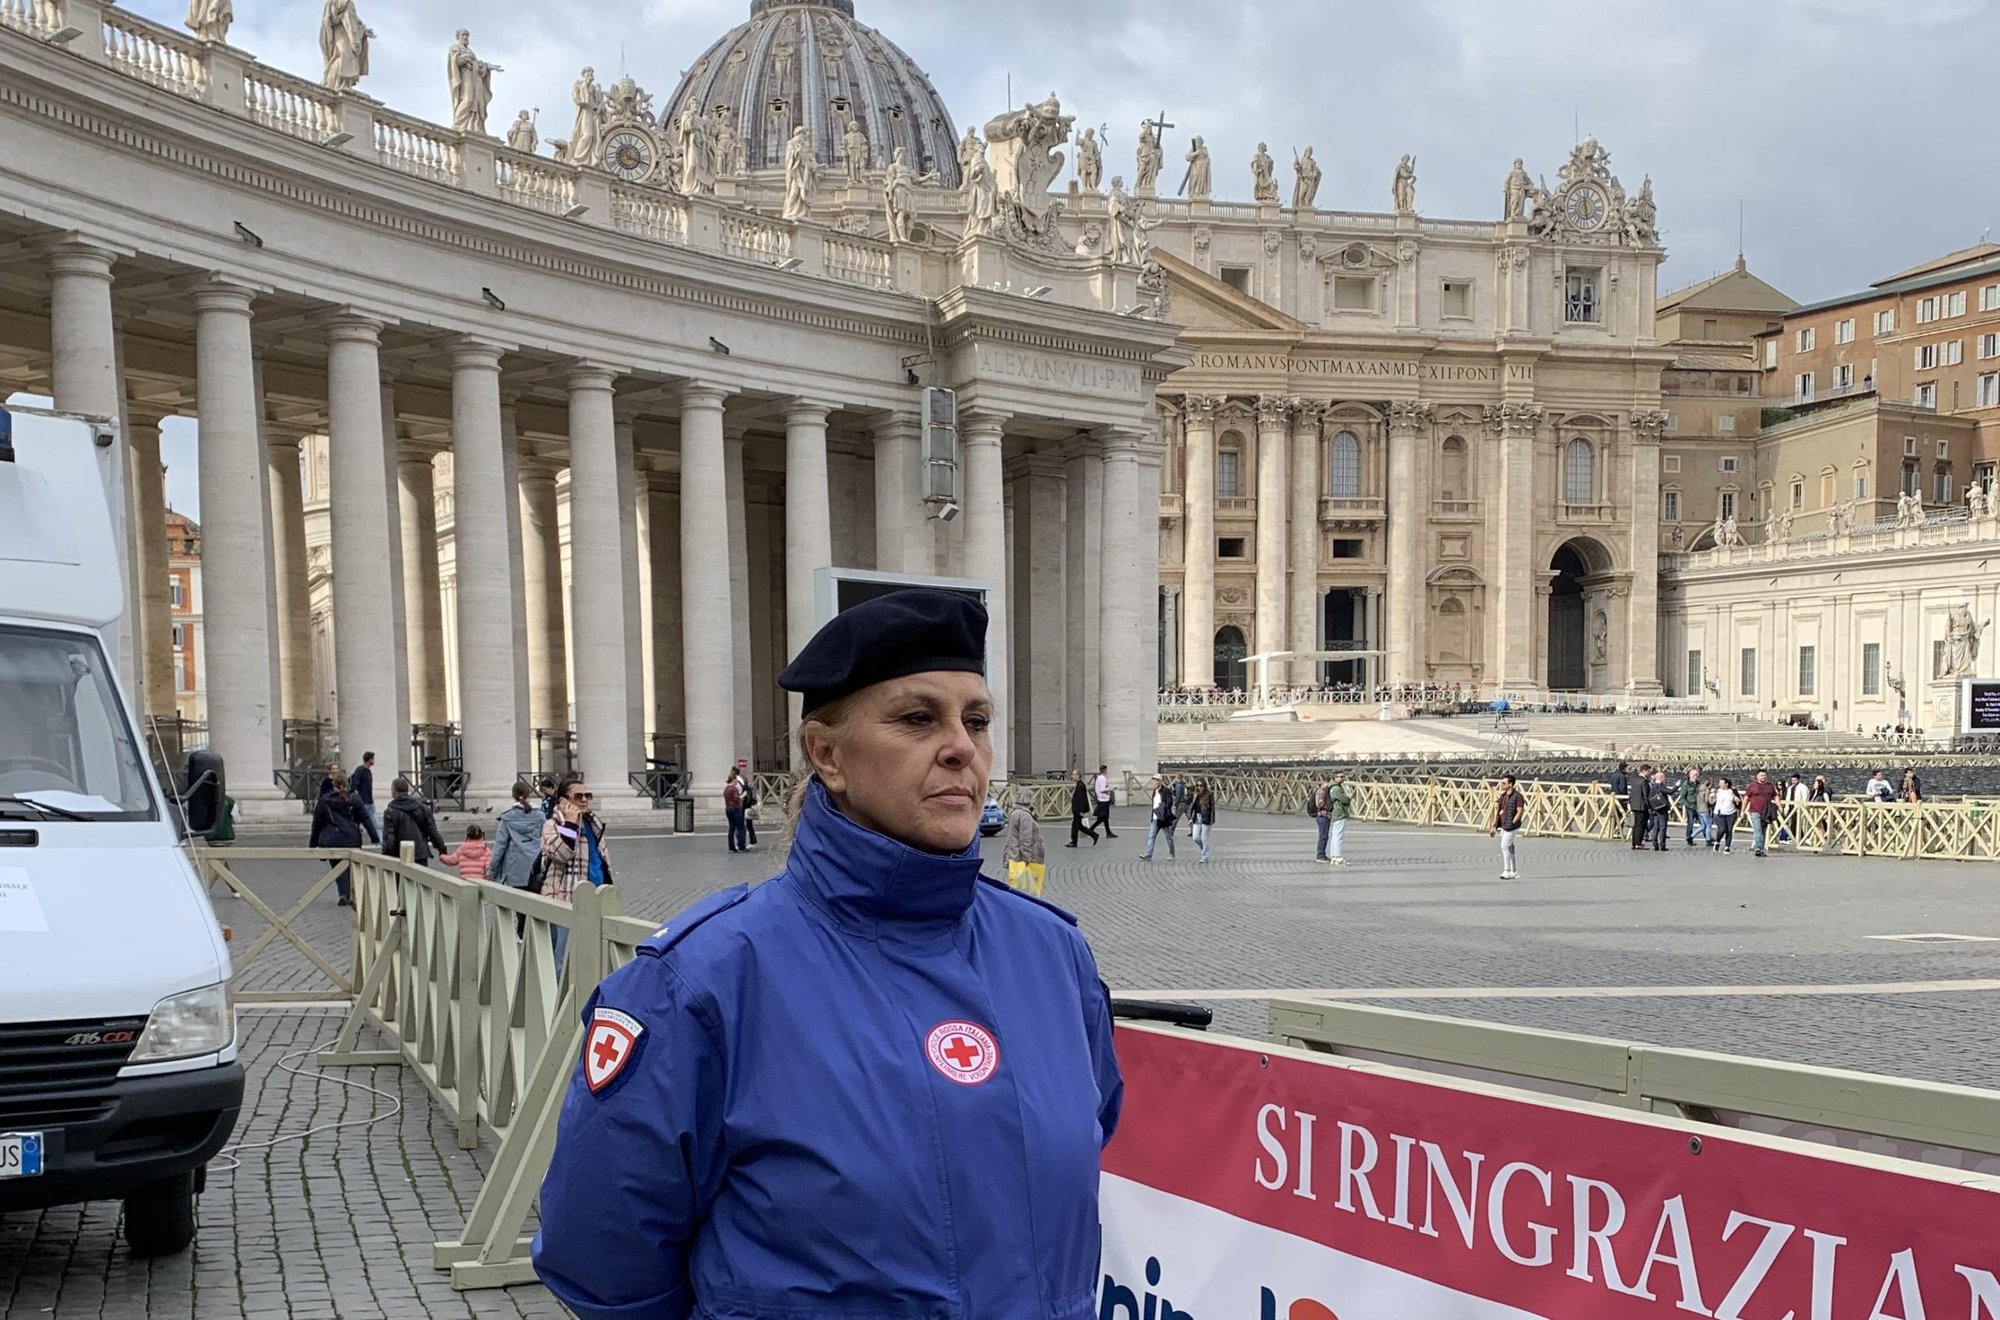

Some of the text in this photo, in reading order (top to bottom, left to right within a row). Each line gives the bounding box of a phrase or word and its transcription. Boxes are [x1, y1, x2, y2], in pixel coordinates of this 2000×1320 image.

[1201, 354, 1287, 370] ROMANVS
[1510, 366, 1532, 379] VII
[64, 1031, 135, 1045] 416 CDI
[938, 1025, 963, 1036] ROSSA
[1255, 1103, 1317, 1200] SI
[1334, 1120, 2000, 1320] RINGRAZIA
